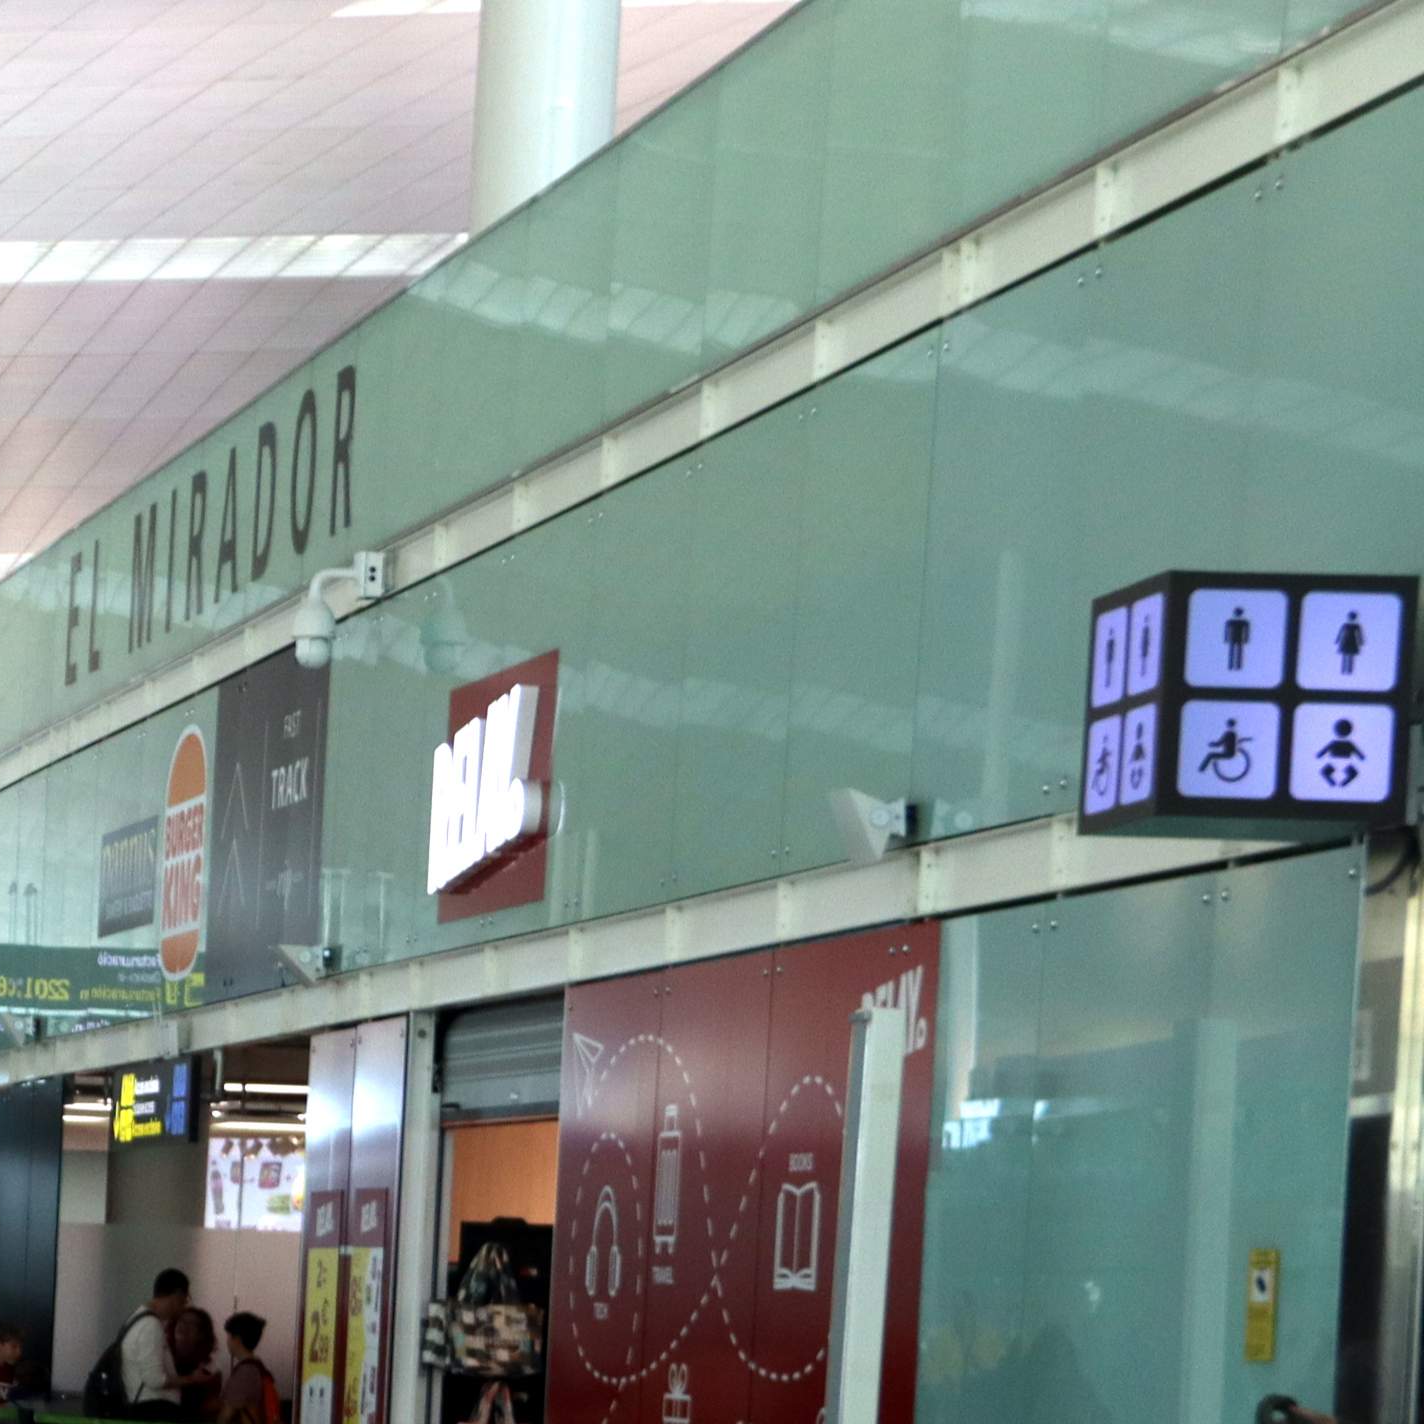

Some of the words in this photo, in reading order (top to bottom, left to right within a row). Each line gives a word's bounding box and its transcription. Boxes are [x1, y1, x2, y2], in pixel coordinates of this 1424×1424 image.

[65, 539, 99, 686] EL
[129, 365, 356, 654] MIRADOR
[271, 756, 309, 809] TRACK
[161, 853, 202, 932] KING
